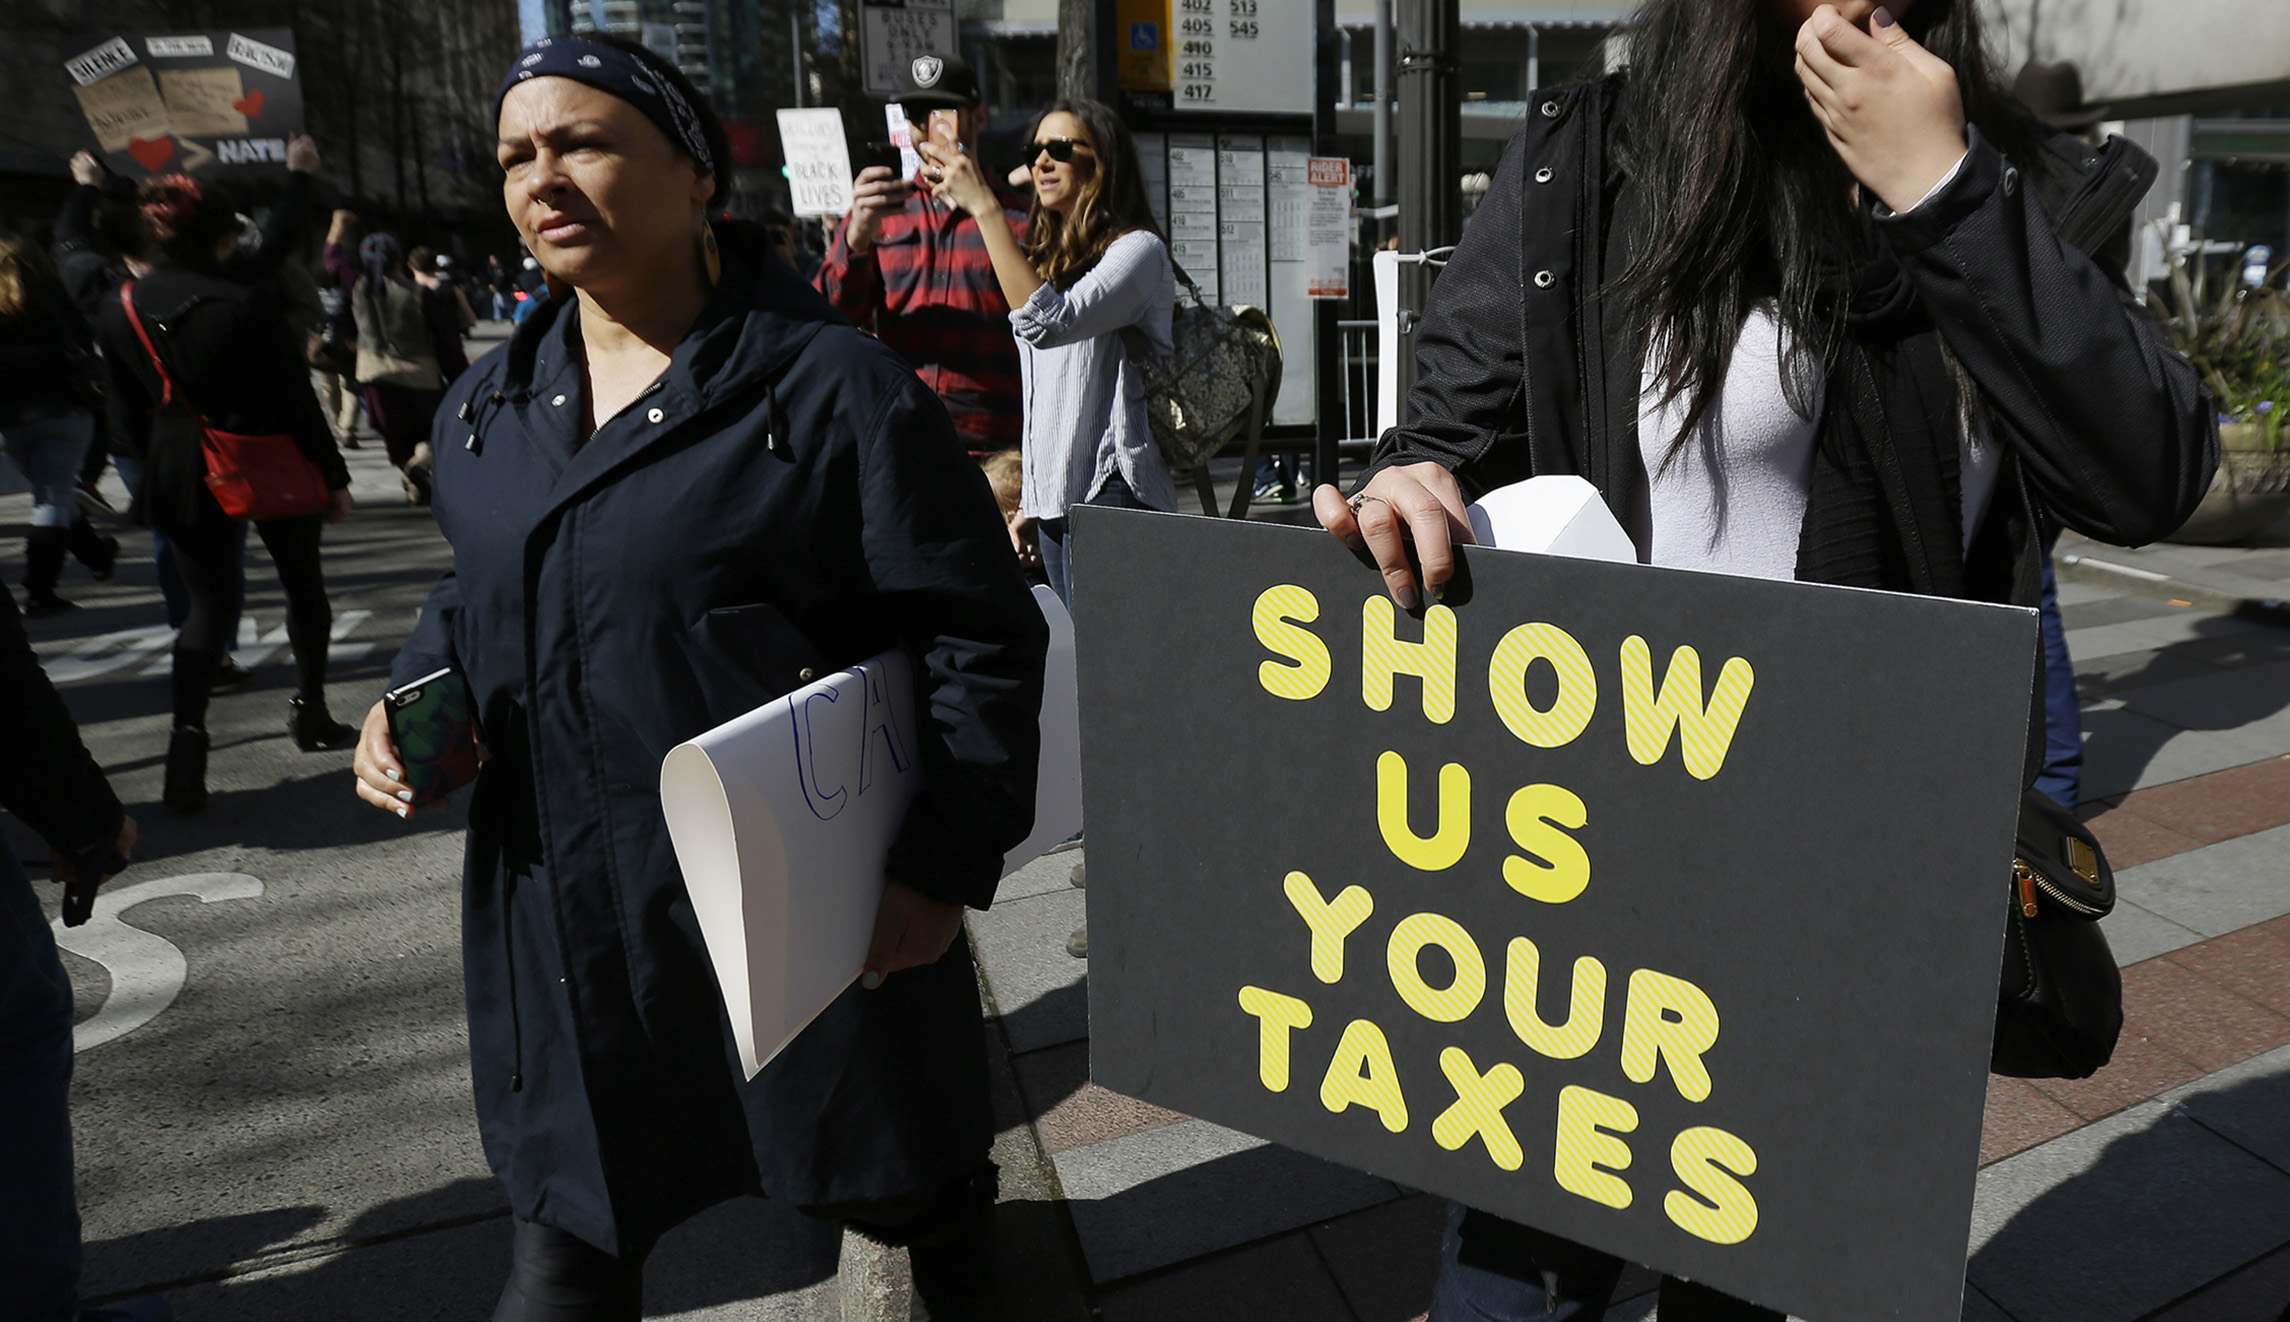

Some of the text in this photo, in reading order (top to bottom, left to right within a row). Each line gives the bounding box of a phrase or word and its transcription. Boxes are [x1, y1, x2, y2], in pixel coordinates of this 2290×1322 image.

[1181, 0, 1257, 13] 402 513
[1182, 18, 1259, 35] 405 545
[1183, 40, 1212, 54] 410
[70, 45, 132, 80] SILENCE
[1183, 63, 1212, 76] 415
[1184, 85, 1212, 98] 417
[793, 161, 840, 180] BLACK
[1310, 161, 1343, 172] RIDER
[1310, 173, 1345, 183] ALERT
[799, 183, 842, 205] LIVES
[1220, 188, 1234, 198] 511
[1221, 224, 1235, 234] 512
[1252, 584, 1755, 781] SHOW
[1376, 750, 1591, 904] US
[1283, 870, 1720, 1103] YOUR
[1238, 985, 1759, 1245] TAXES
